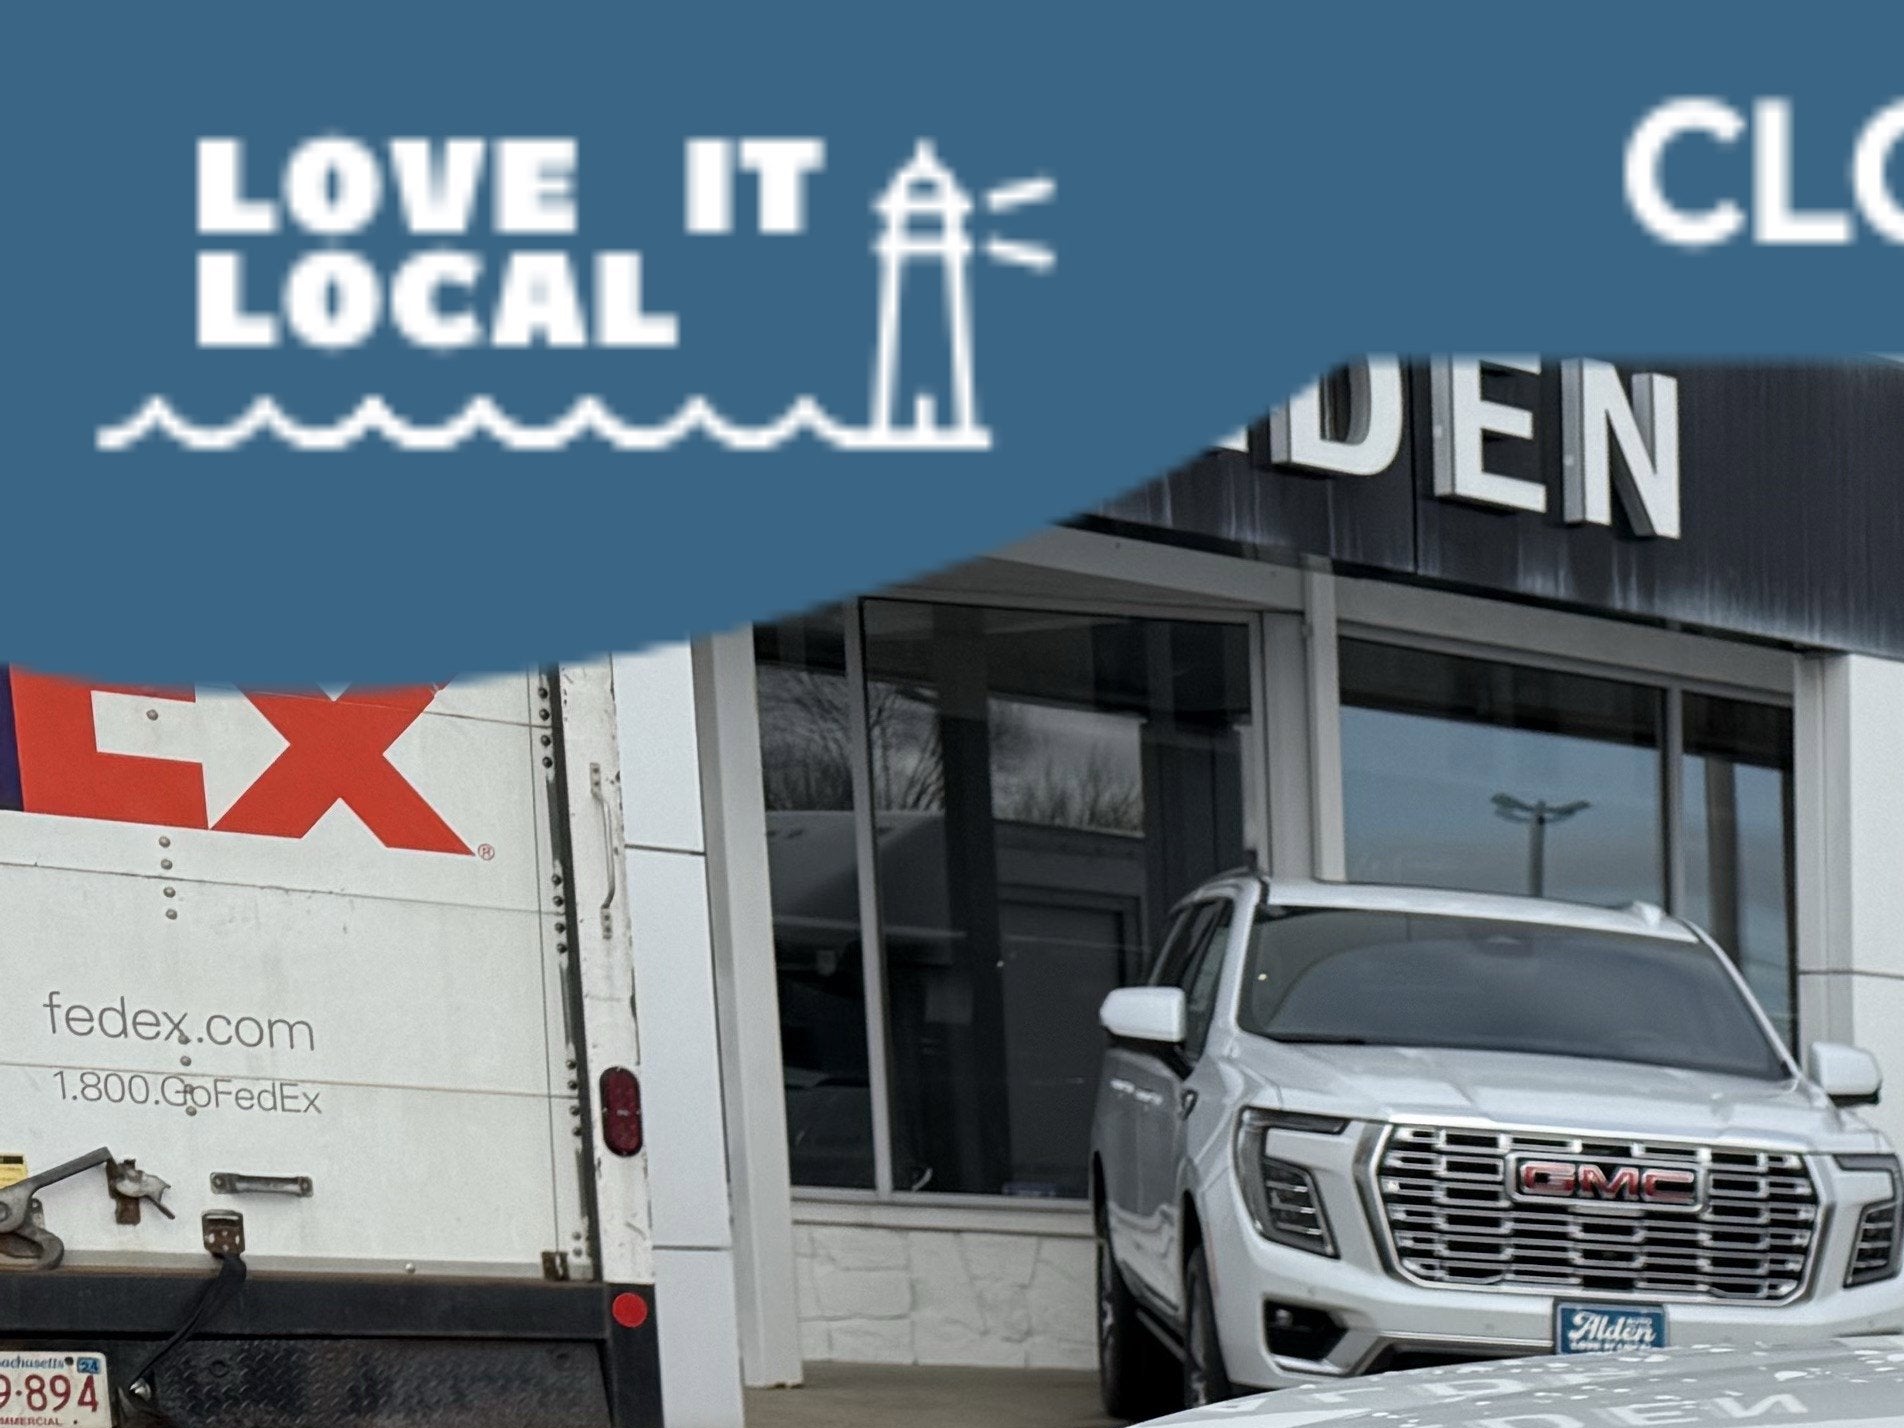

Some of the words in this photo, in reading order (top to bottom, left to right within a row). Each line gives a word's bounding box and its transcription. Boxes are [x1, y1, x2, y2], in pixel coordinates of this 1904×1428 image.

[1216, 352, 1680, 540] DEN
[43, 991, 315, 1051] fedex.com
[53, 1070, 322, 1115] 1.800.GoFedEx
[1519, 1160, 1695, 1204] GMC
[1567, 1311, 1657, 1343] Alden
[0, 1355, 65, 1369] achusetts
